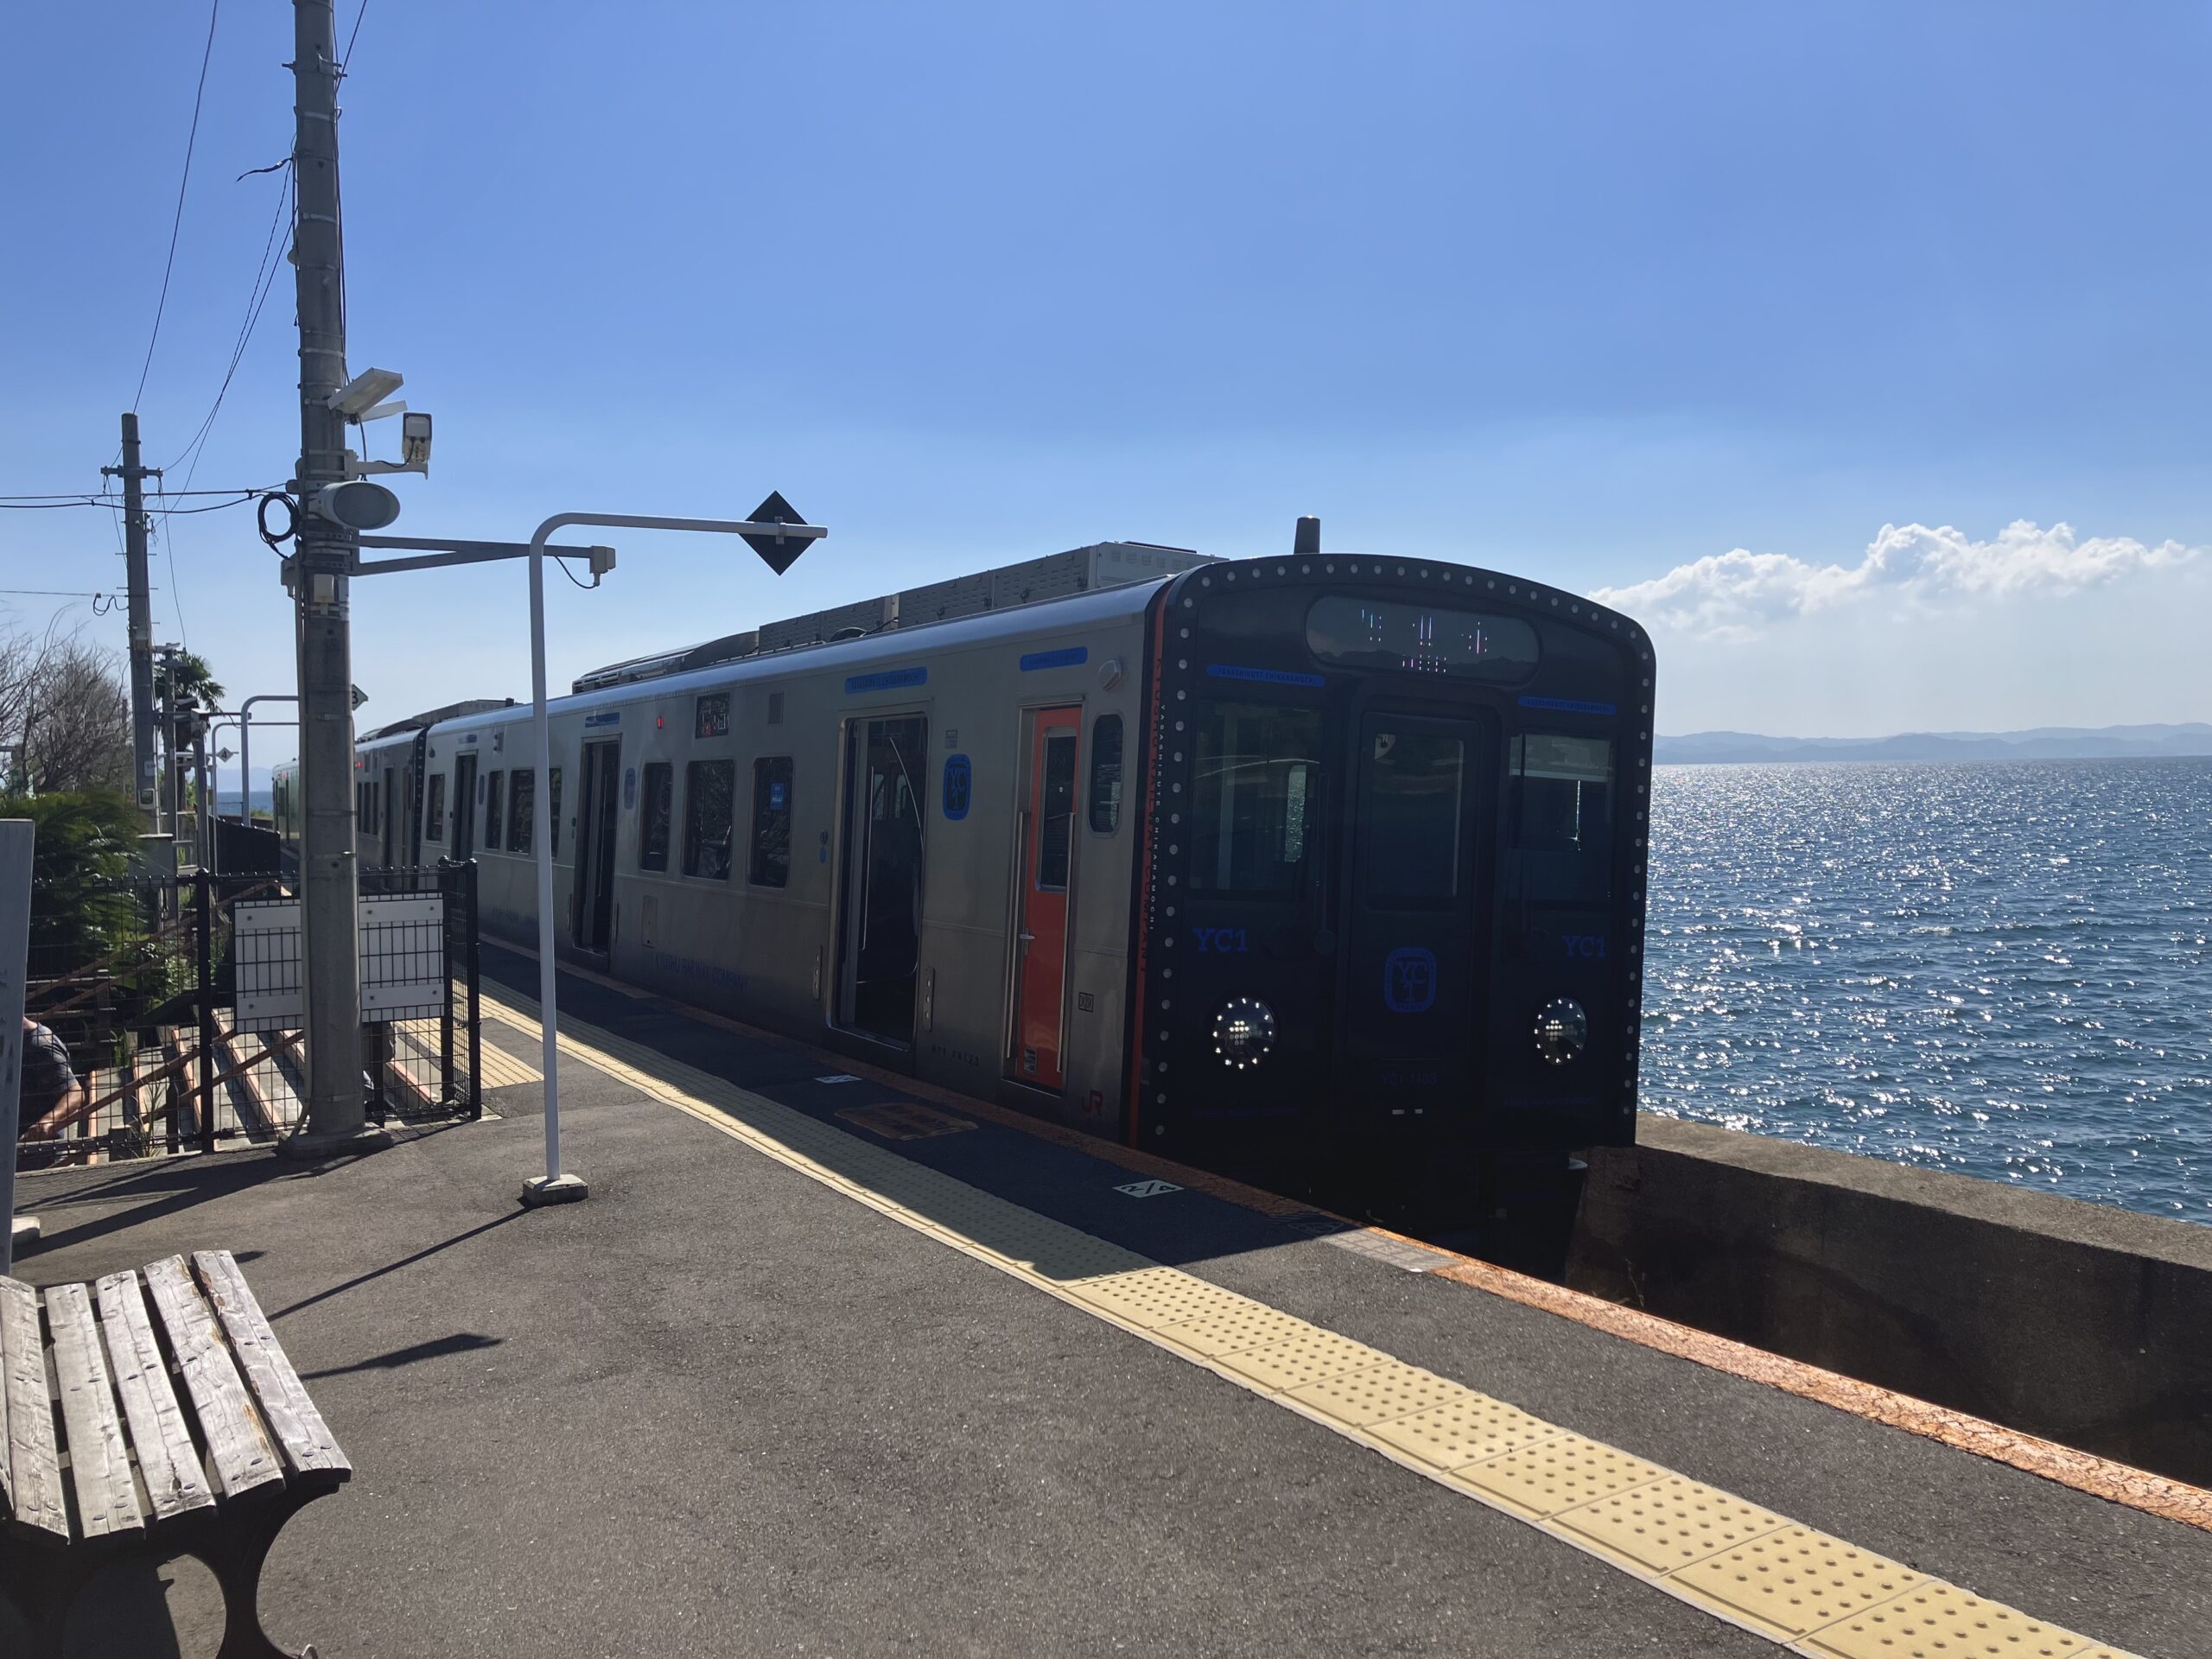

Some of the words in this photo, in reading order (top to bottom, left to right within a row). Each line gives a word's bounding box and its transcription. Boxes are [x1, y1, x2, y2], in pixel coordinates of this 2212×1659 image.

[221, 750, 227, 759] 4
[1156, 704, 1166, 806] YASASHIKUTE
[1149, 817, 1160, 931] CHIKARAMOCHI
[1192, 926, 1249, 953] YC1
[1561, 934, 1607, 958] YC1
[1078, 1090, 1103, 1116] JR
